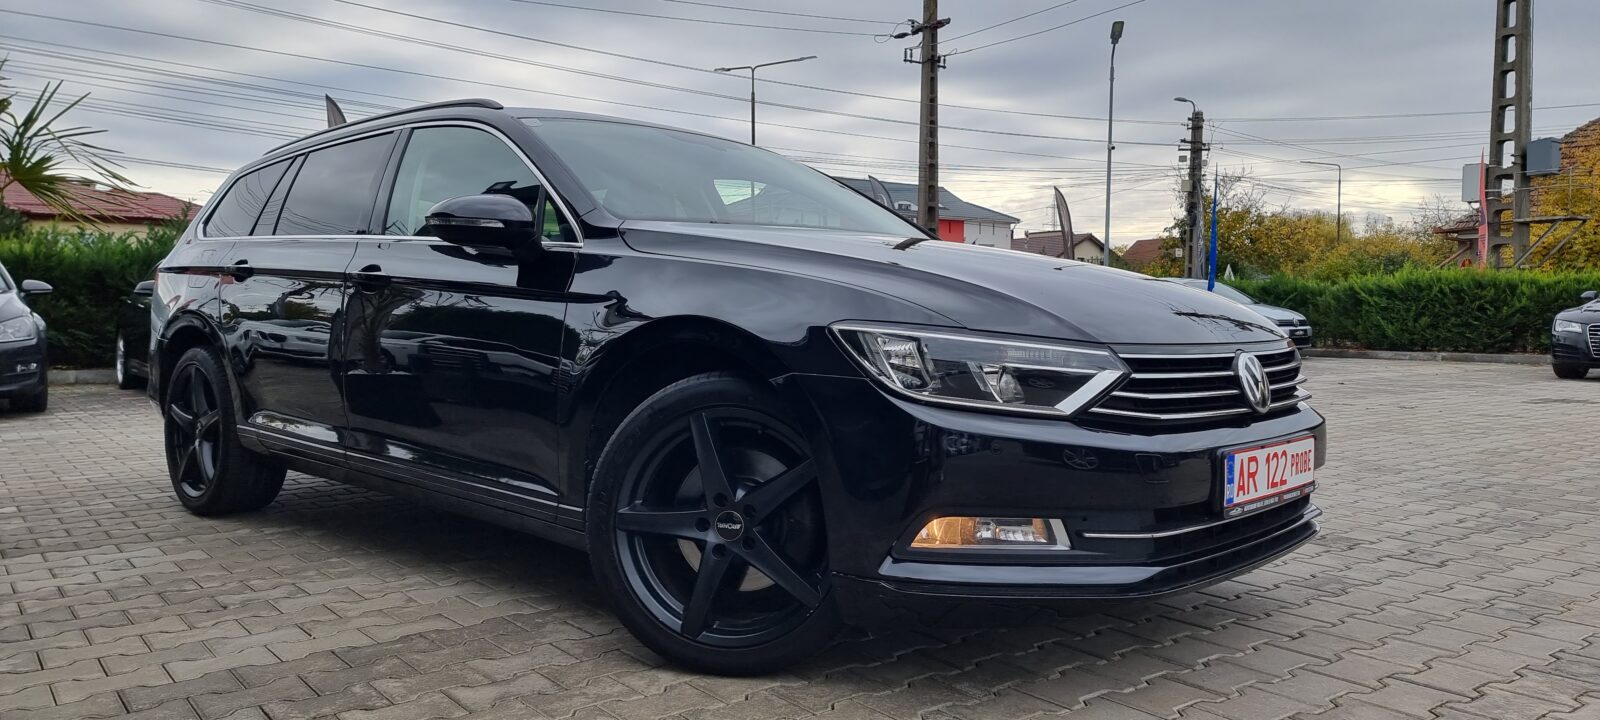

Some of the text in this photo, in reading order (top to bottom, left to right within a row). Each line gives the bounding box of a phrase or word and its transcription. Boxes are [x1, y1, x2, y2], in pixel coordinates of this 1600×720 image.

[1236, 449, 1312, 497] AR 122 PROBE
